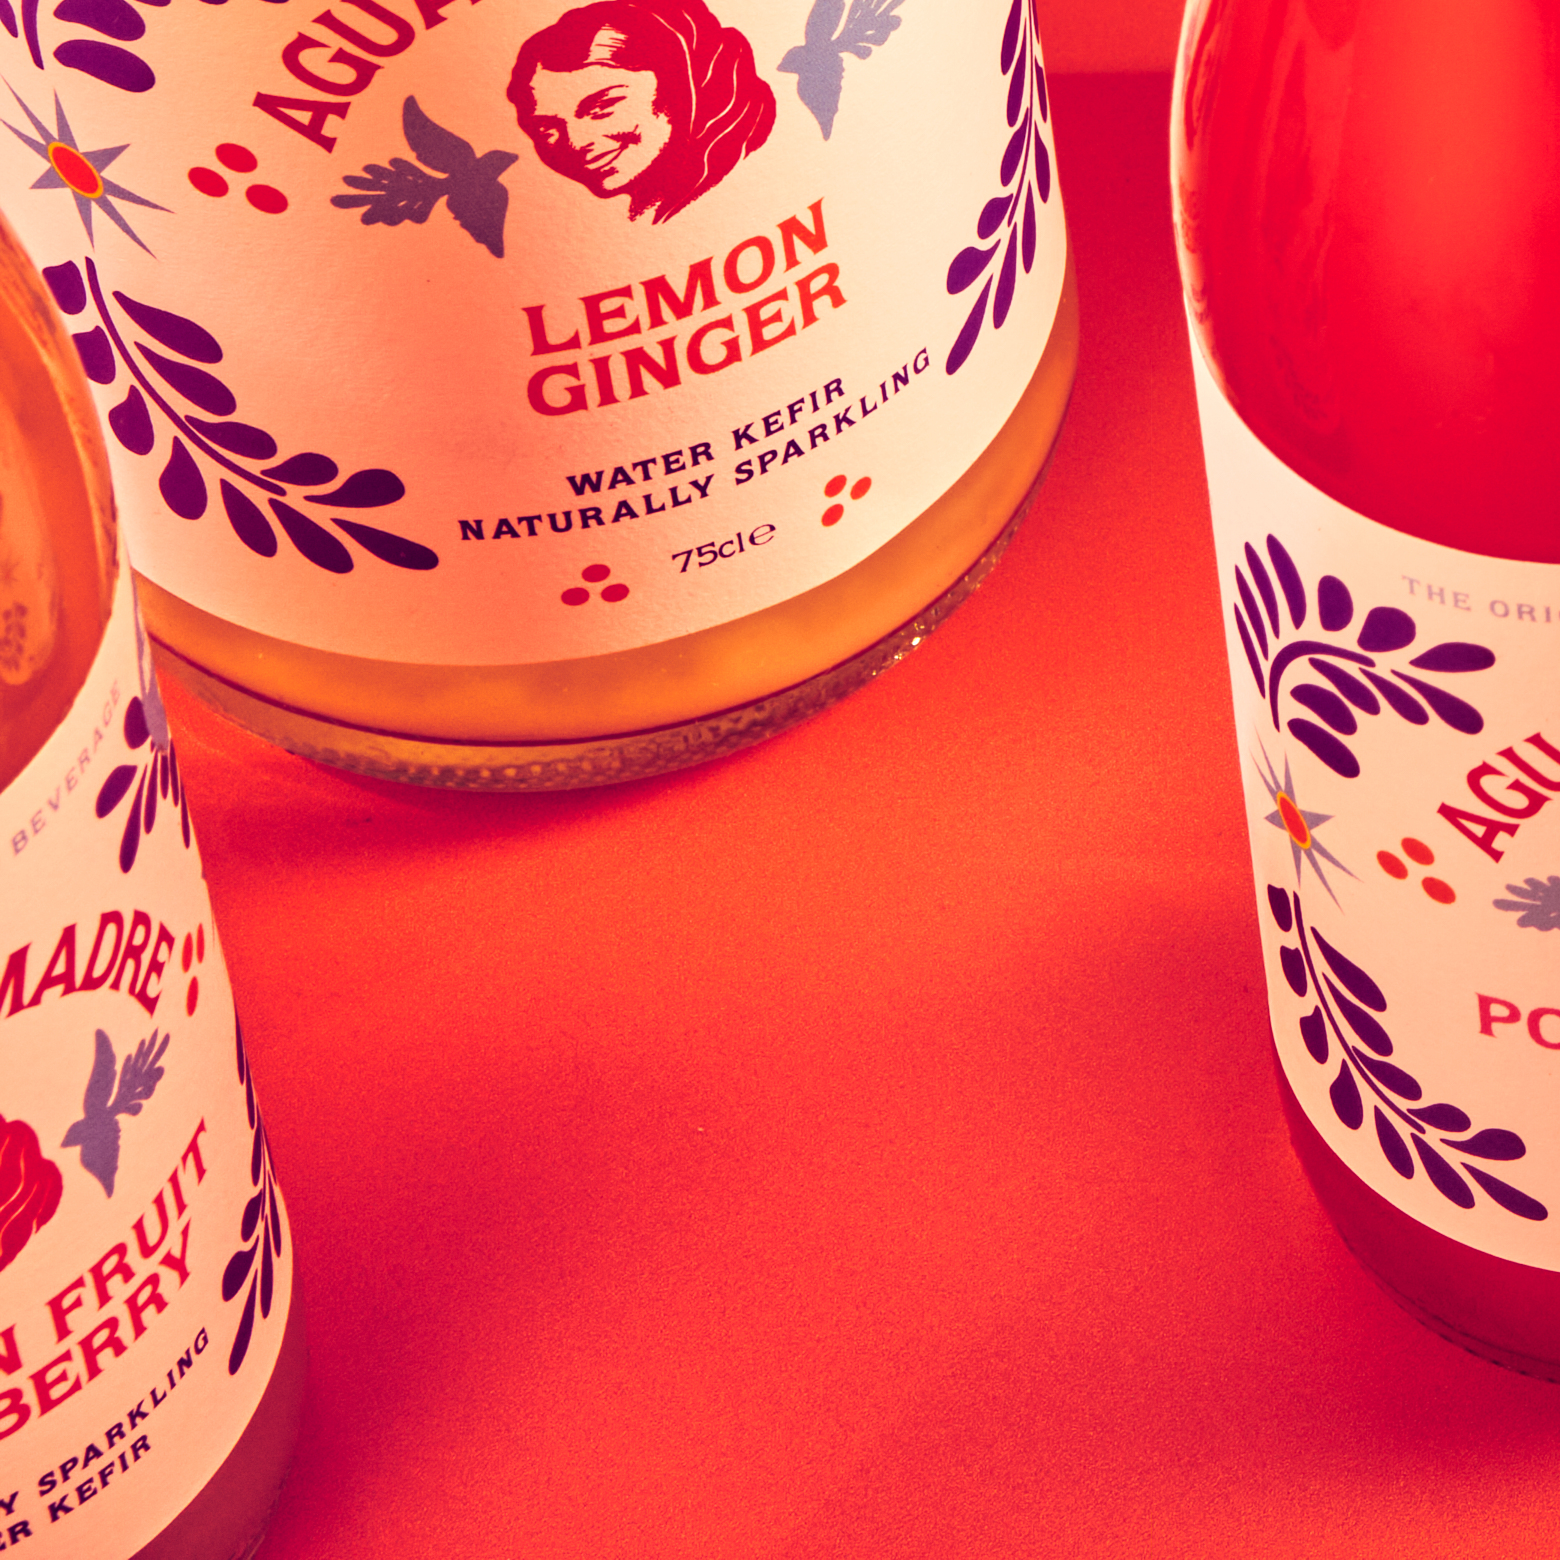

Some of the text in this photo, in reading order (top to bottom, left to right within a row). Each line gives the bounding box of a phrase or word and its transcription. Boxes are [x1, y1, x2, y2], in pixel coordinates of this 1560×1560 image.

[521, 197, 831, 358] LEMON
[526, 262, 849, 417] GINGER
[457, 347, 932, 542] NATURALLY SPARKLING
[566, 376, 846, 497] WATER KEFIR
[1401, 574, 1472, 612] THE
[11, 679, 122, 856] BEVERAGE
[45, 1116, 207, 1344] FRUIT
[38, 1327, 210, 1497] SPARKLING
[47, 1434, 151, 1524] KEFIR
